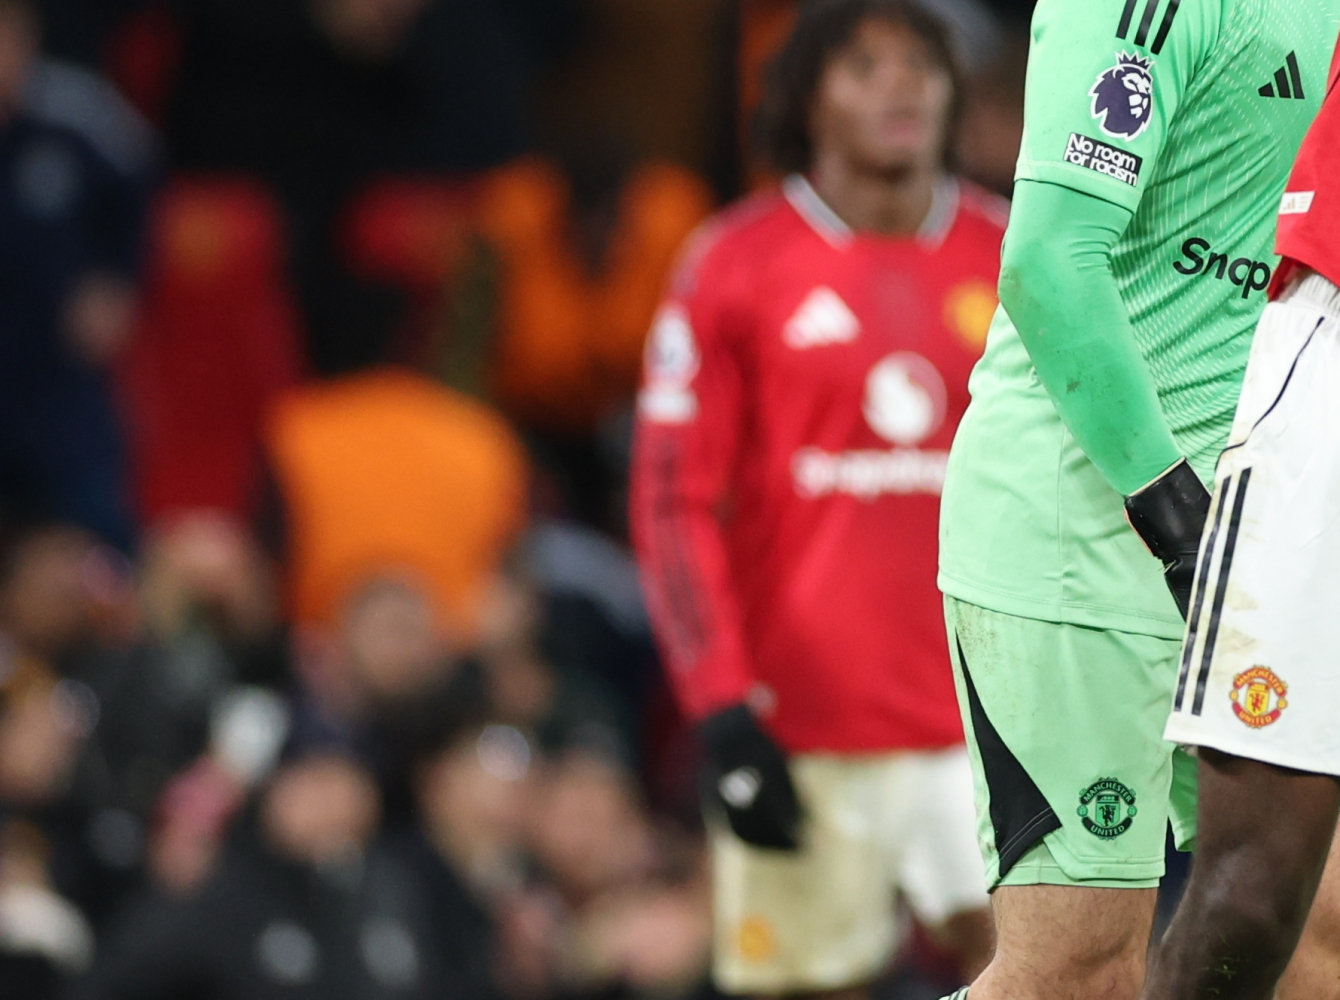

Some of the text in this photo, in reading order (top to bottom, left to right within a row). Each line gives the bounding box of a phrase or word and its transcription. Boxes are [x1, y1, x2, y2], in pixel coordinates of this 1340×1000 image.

[1067, 133, 1137, 171] No room
[1063, 147, 1138, 187] for racism
[1239, 710, 1272, 725] UNITED
[1083, 782, 1133, 802] MANCHESTER
[1090, 825, 1125, 836] UNITED
